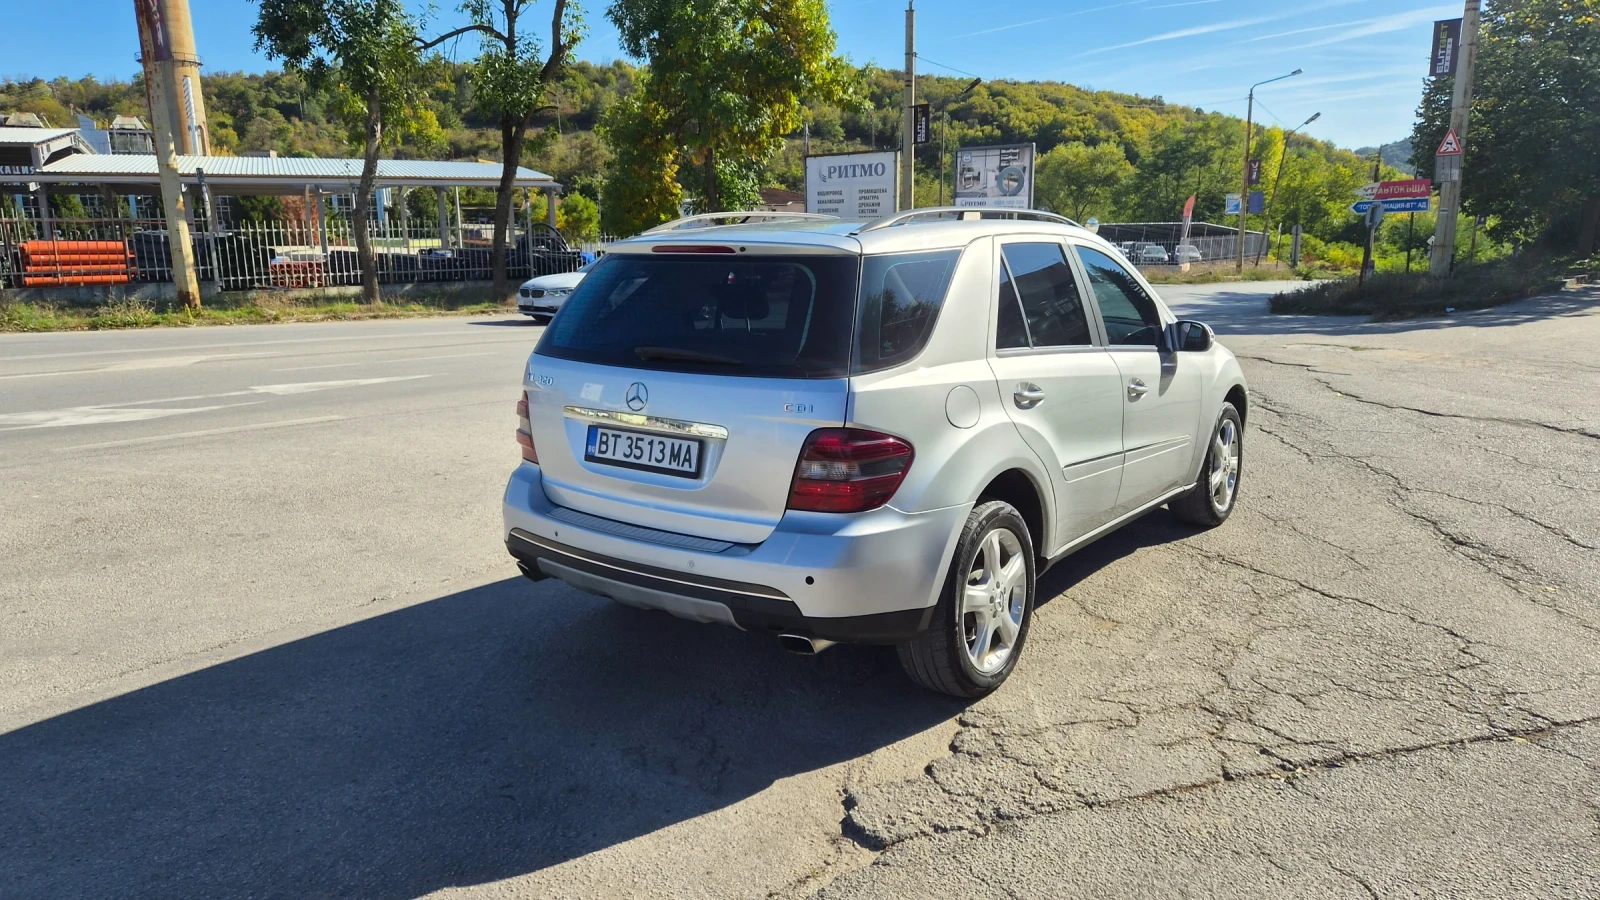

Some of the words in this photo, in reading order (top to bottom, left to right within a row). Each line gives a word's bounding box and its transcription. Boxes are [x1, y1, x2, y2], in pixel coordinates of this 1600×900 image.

[1436, 23, 1448, 74] ELITBET
[827, 162, 886, 179] РИТМО
[1377, 184, 1427, 195] АВТОКЪЩА
[538, 374, 554, 386] 320
[784, 403, 814, 413] CDI
[598, 431, 622, 457] BT
[622, 436, 666, 464] 3513
[668, 442, 693, 469] MA
